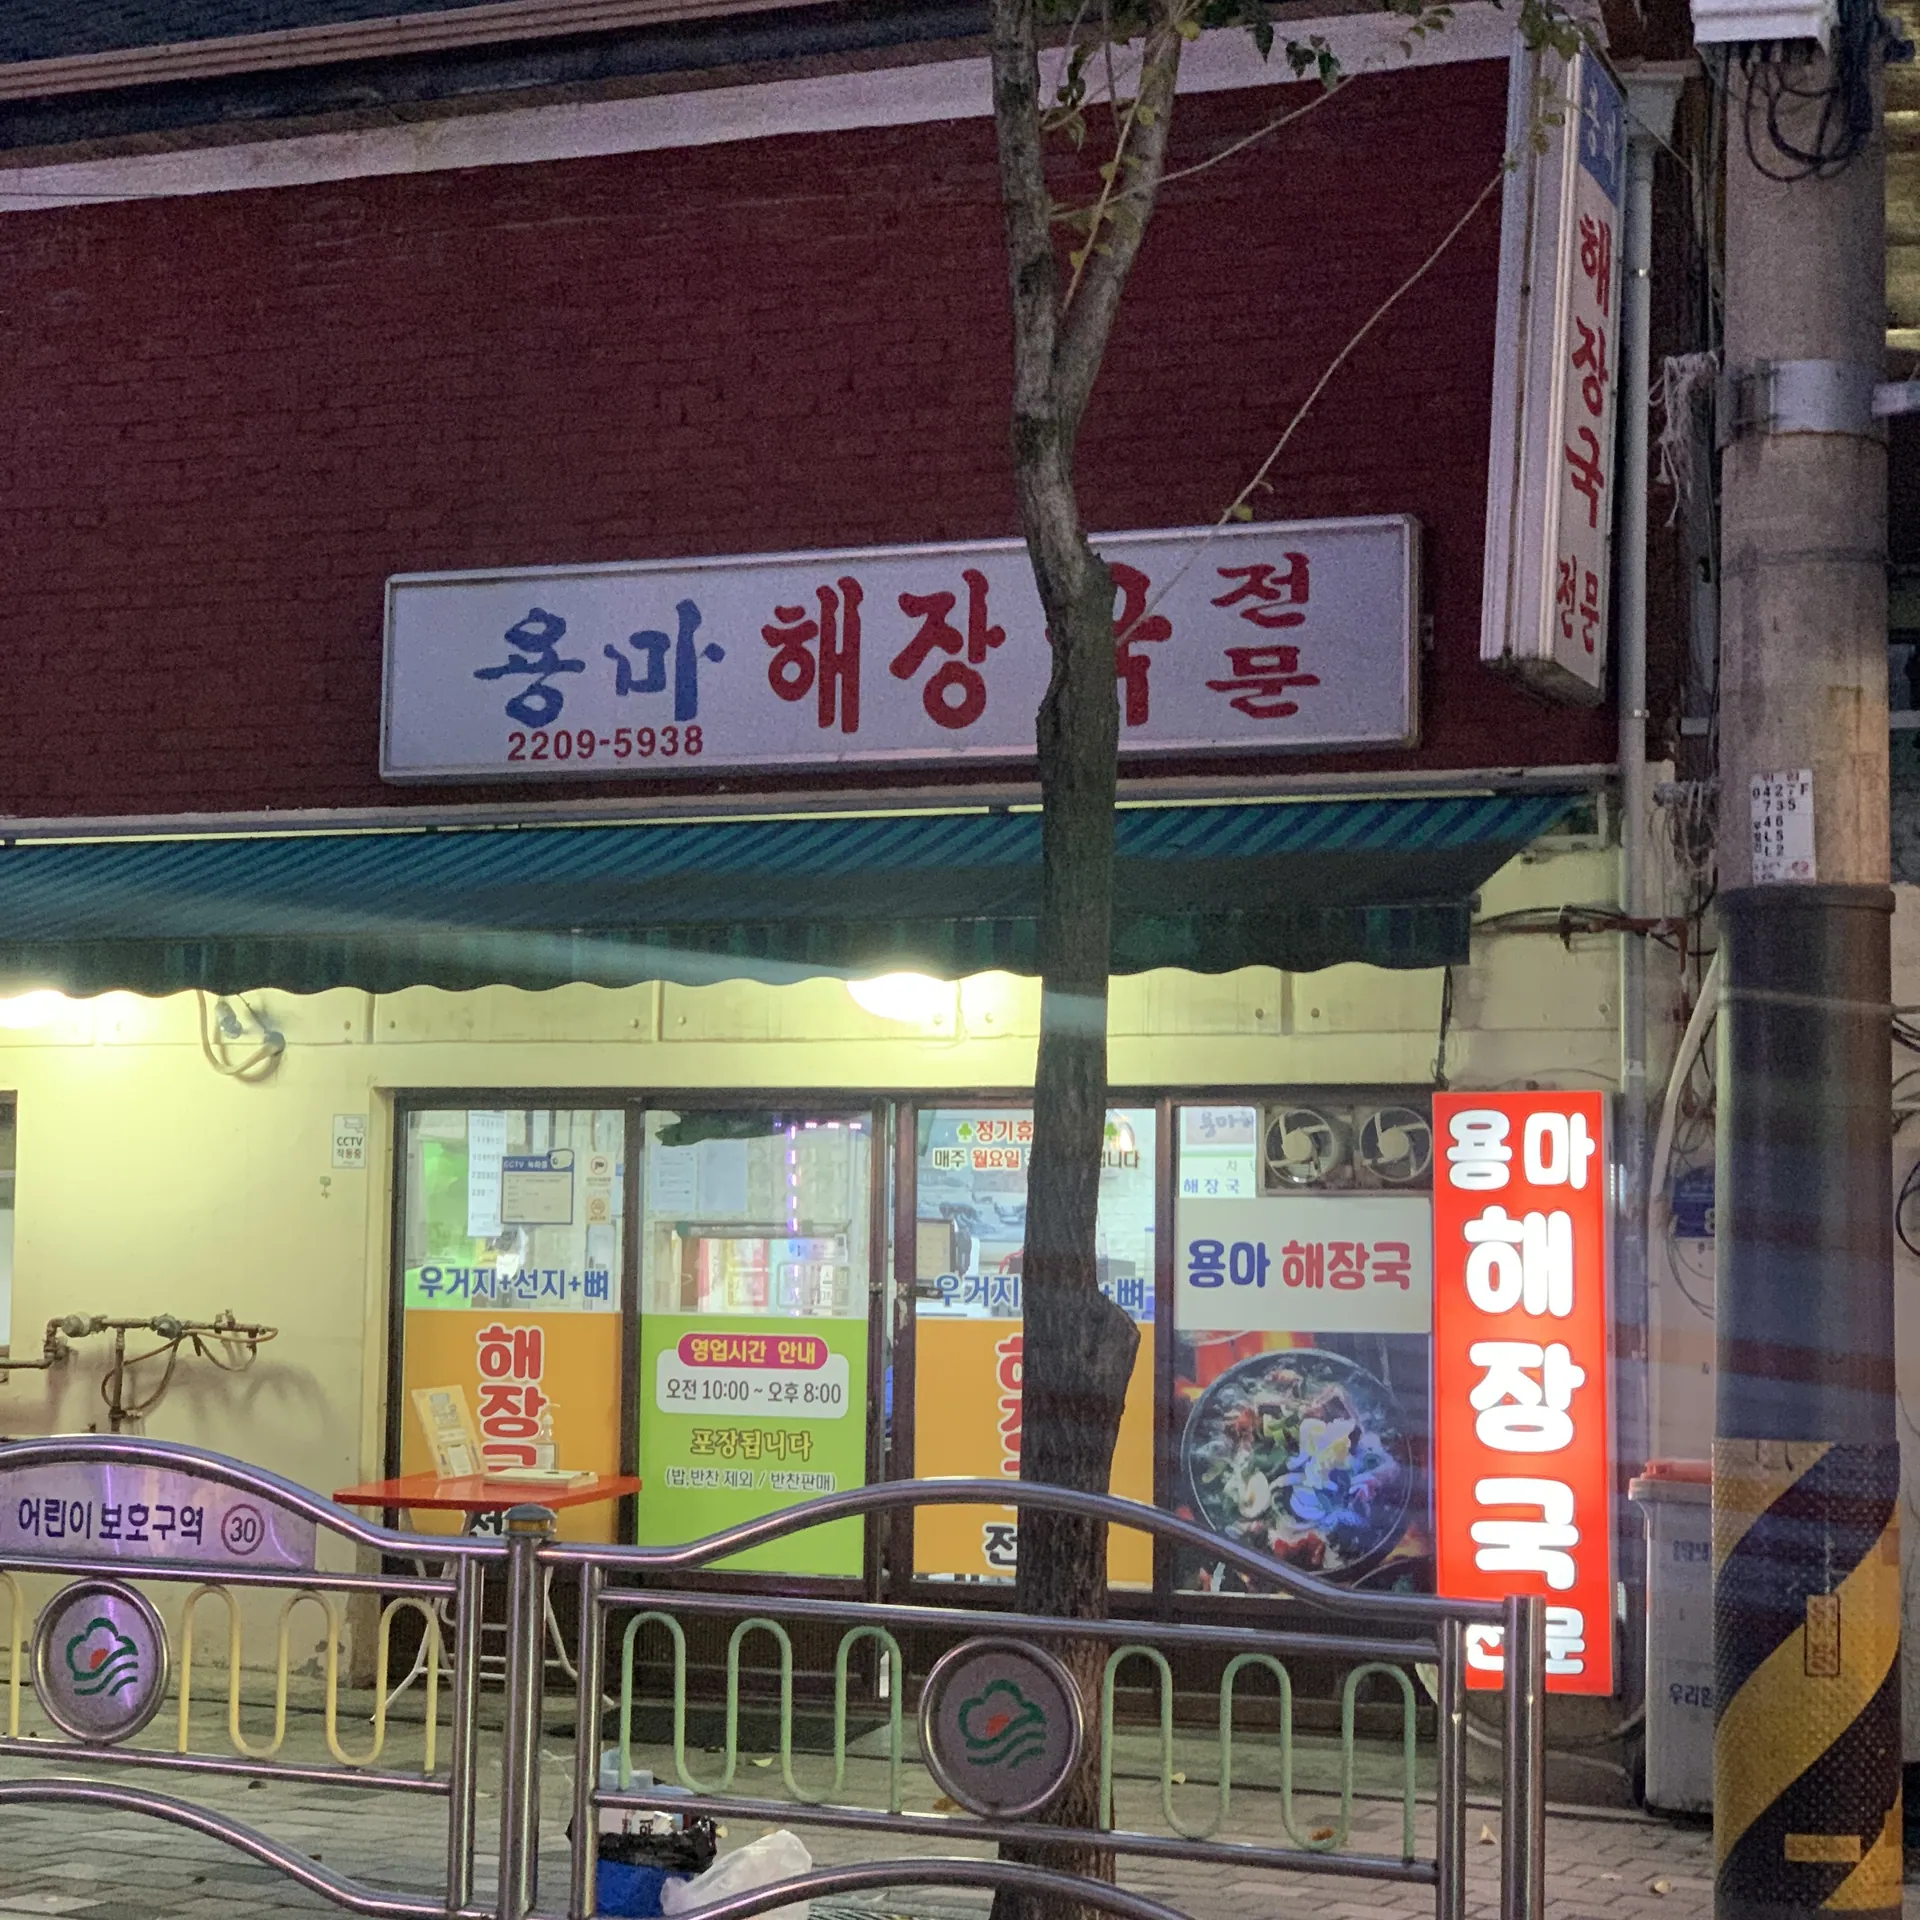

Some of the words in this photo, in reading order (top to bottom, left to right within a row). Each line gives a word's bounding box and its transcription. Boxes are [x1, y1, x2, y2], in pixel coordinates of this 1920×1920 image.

[1565, 213, 1612, 528] 해장국
[1556, 555, 1599, 654] 전문
[1206, 552, 1321, 719] 전문
[473, 598, 725, 728] 용마
[507, 725, 704, 762] 2209-5938
[336, 1136, 363, 1147] CCTV
[934, 1150, 966, 1168] 매주
[972, 1150, 1020, 1169] 월요일
[1281, 1239, 1412, 1291] 해장국
[690, 1338, 767, 1364] 영업시간
[777, 1340, 816, 1365] 안내
[666, 1378, 697, 1400] 오전
[702, 1379, 749, 1401] 10:00
[767, 1381, 799, 1403] 오후
[803, 1383, 841, 1404] 8:00
[1463, 1204, 1586, 1591] 해장국
[690, 1428, 813, 1462] 포장됩니다
[723, 1470, 753, 1487] 제외
[18, 1498, 93, 1540] 어린이
[99, 1502, 204, 1545] 보호구역
[229, 1516, 256, 1543] 30
